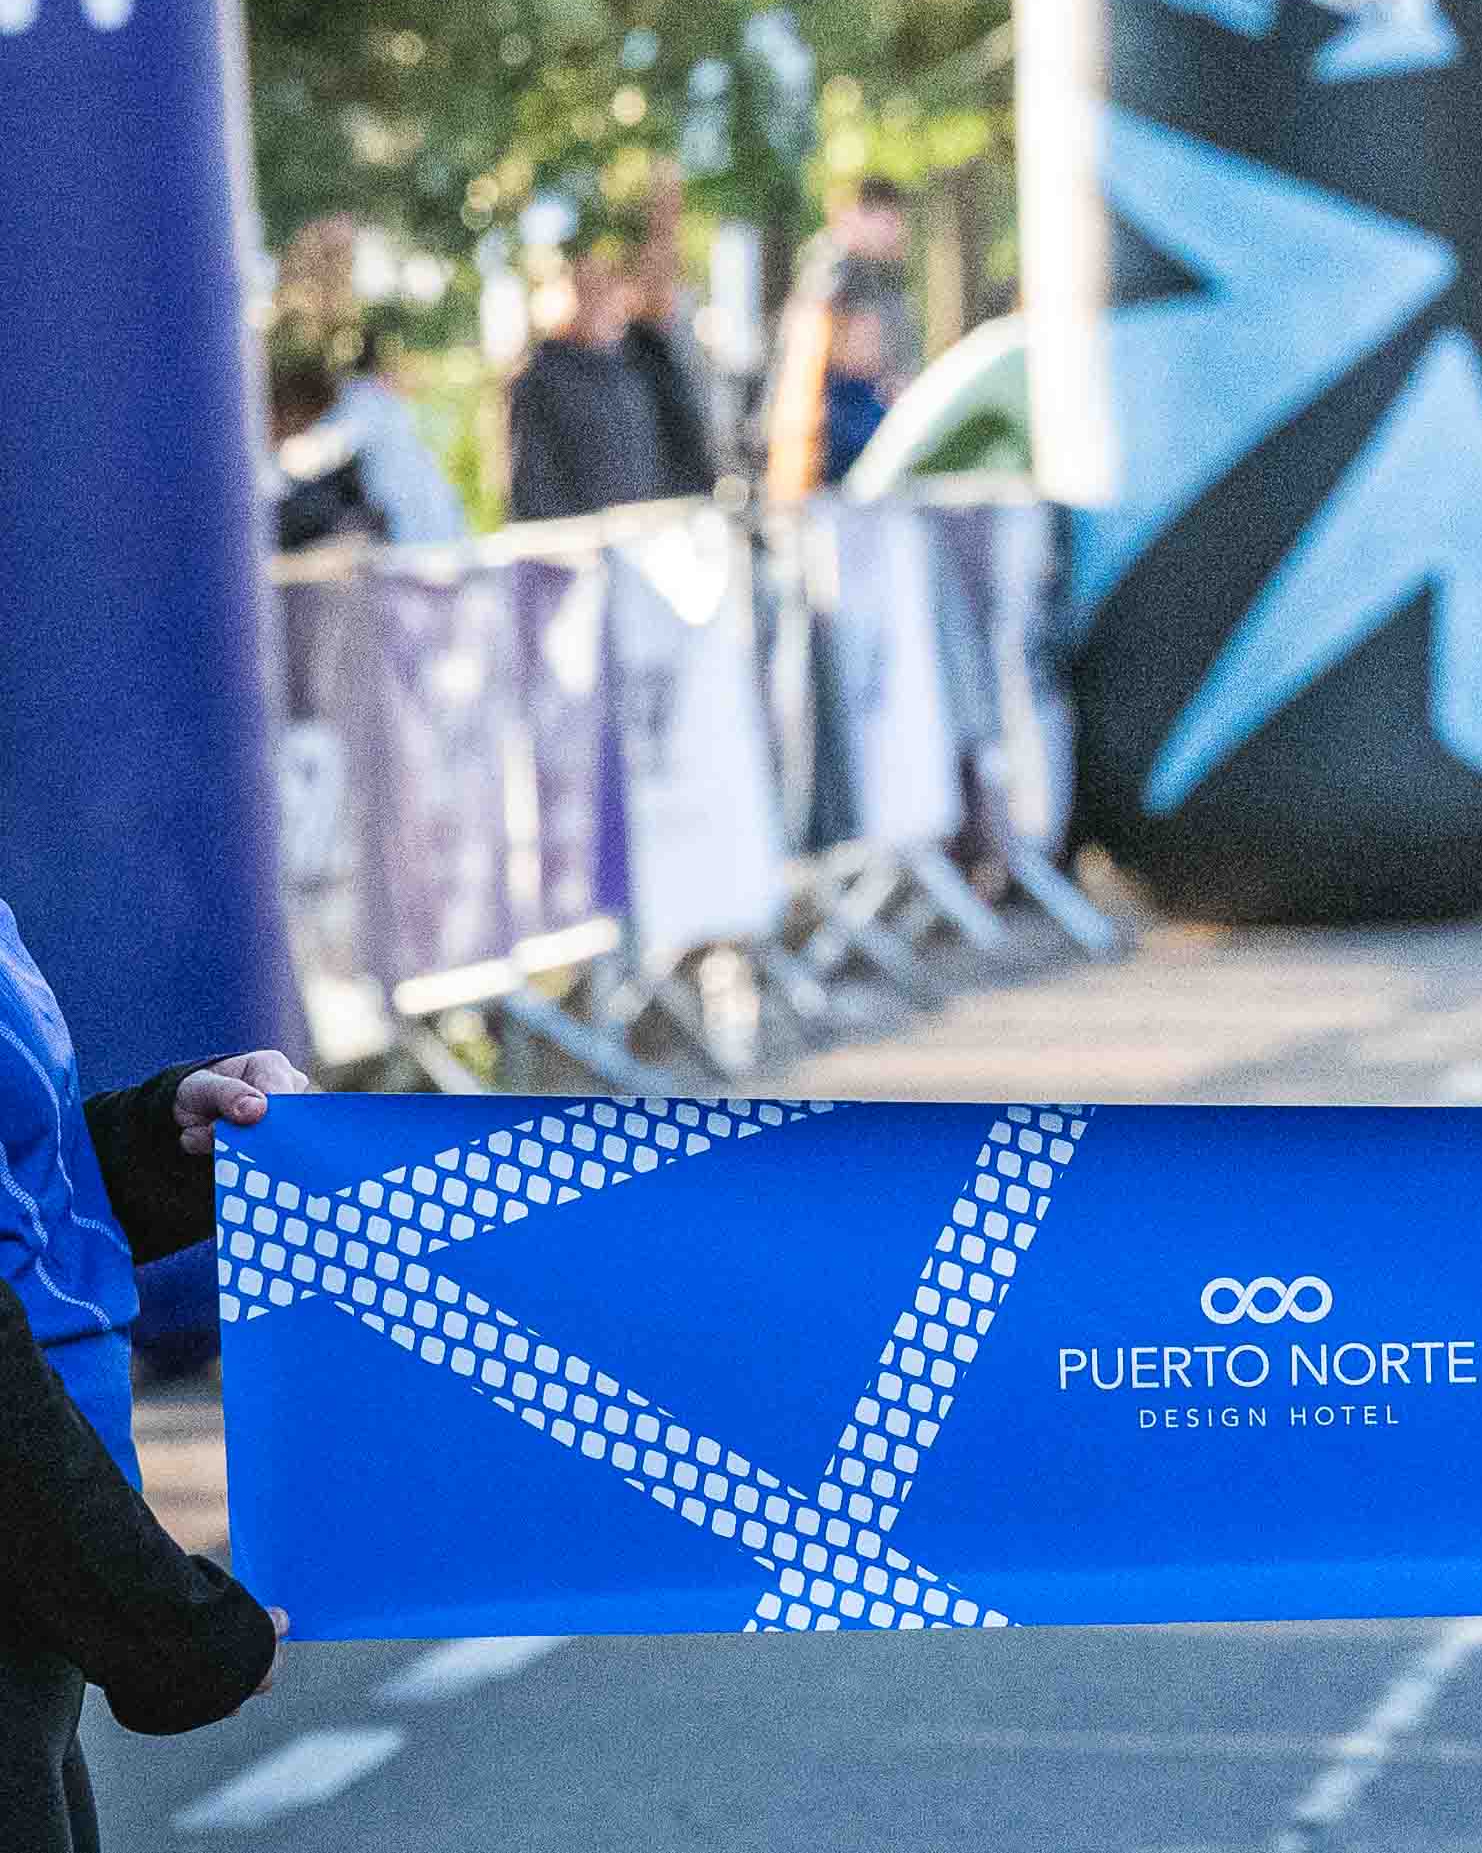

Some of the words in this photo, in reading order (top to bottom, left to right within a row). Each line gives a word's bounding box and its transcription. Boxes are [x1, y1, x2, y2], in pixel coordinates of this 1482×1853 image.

[1058, 1344, 1271, 1391] PUERTO
[1291, 1340, 1478, 1386] NORTE
[1139, 1404, 1268, 1429] DESIGN
[1289, 1403, 1400, 1428] HOTEL
